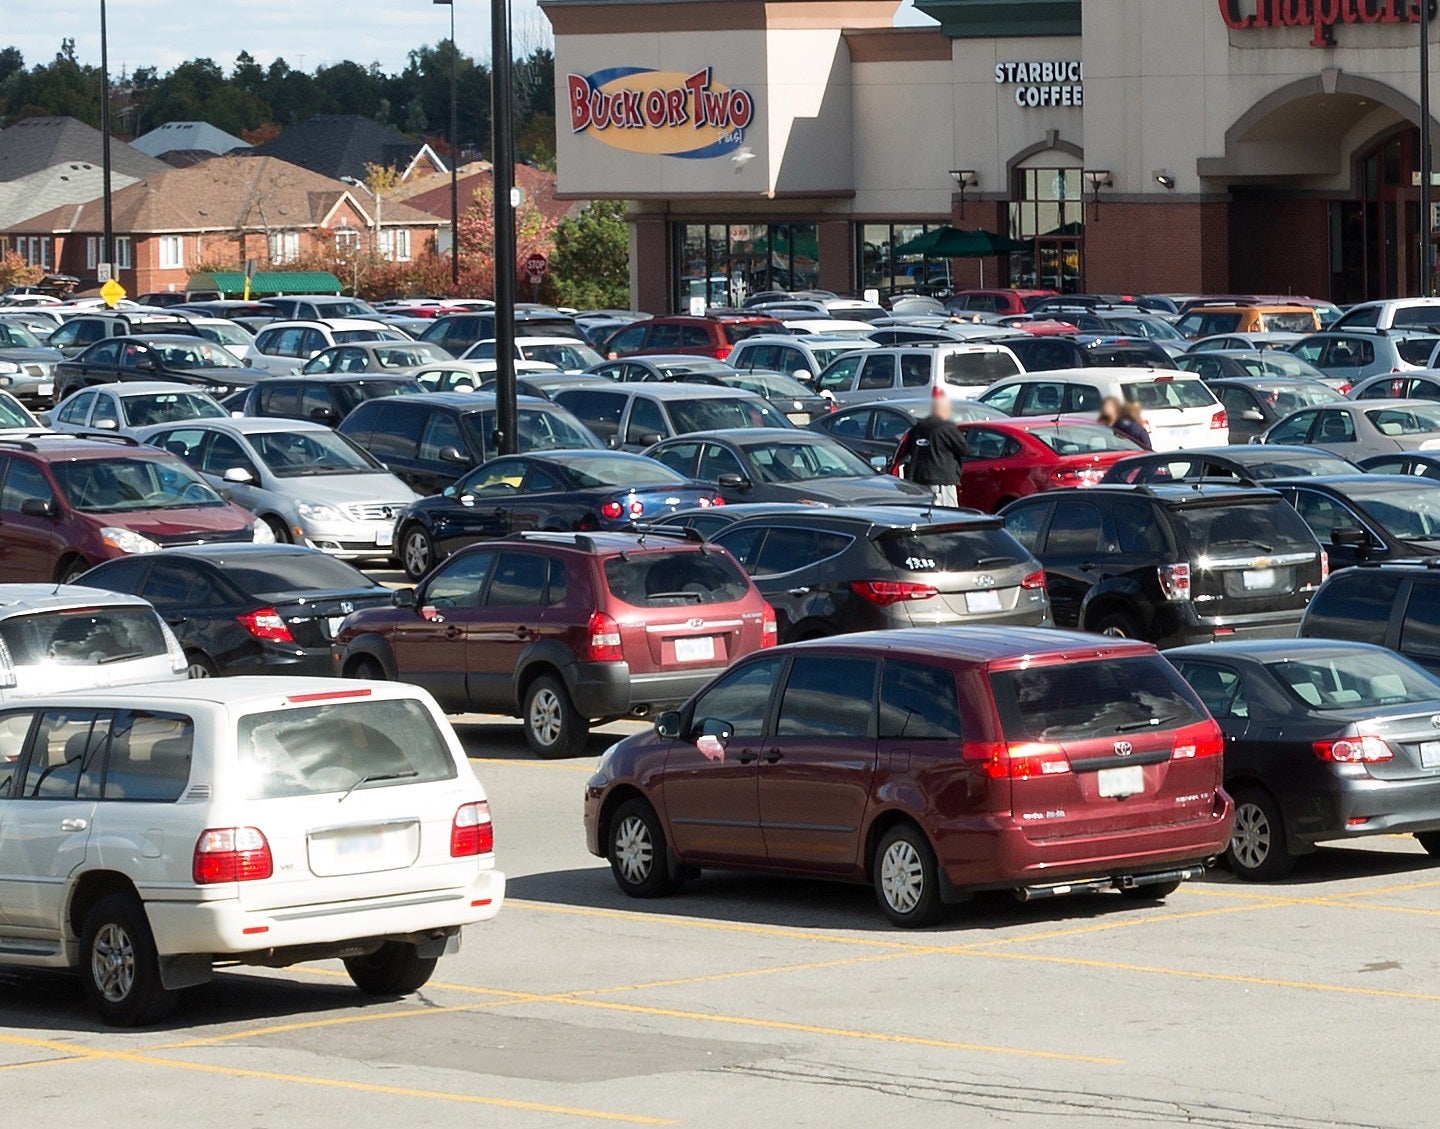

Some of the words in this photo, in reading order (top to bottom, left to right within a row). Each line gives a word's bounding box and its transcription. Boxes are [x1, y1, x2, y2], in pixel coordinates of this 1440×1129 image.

[995, 62, 1083, 84] STARBUC
[567, 74, 644, 134] BUCK
[646, 89, 688, 128] OR
[684, 67, 753, 129] TWO
[1015, 85, 1082, 107] COFFEE
[528, 260, 545, 269] STOP
